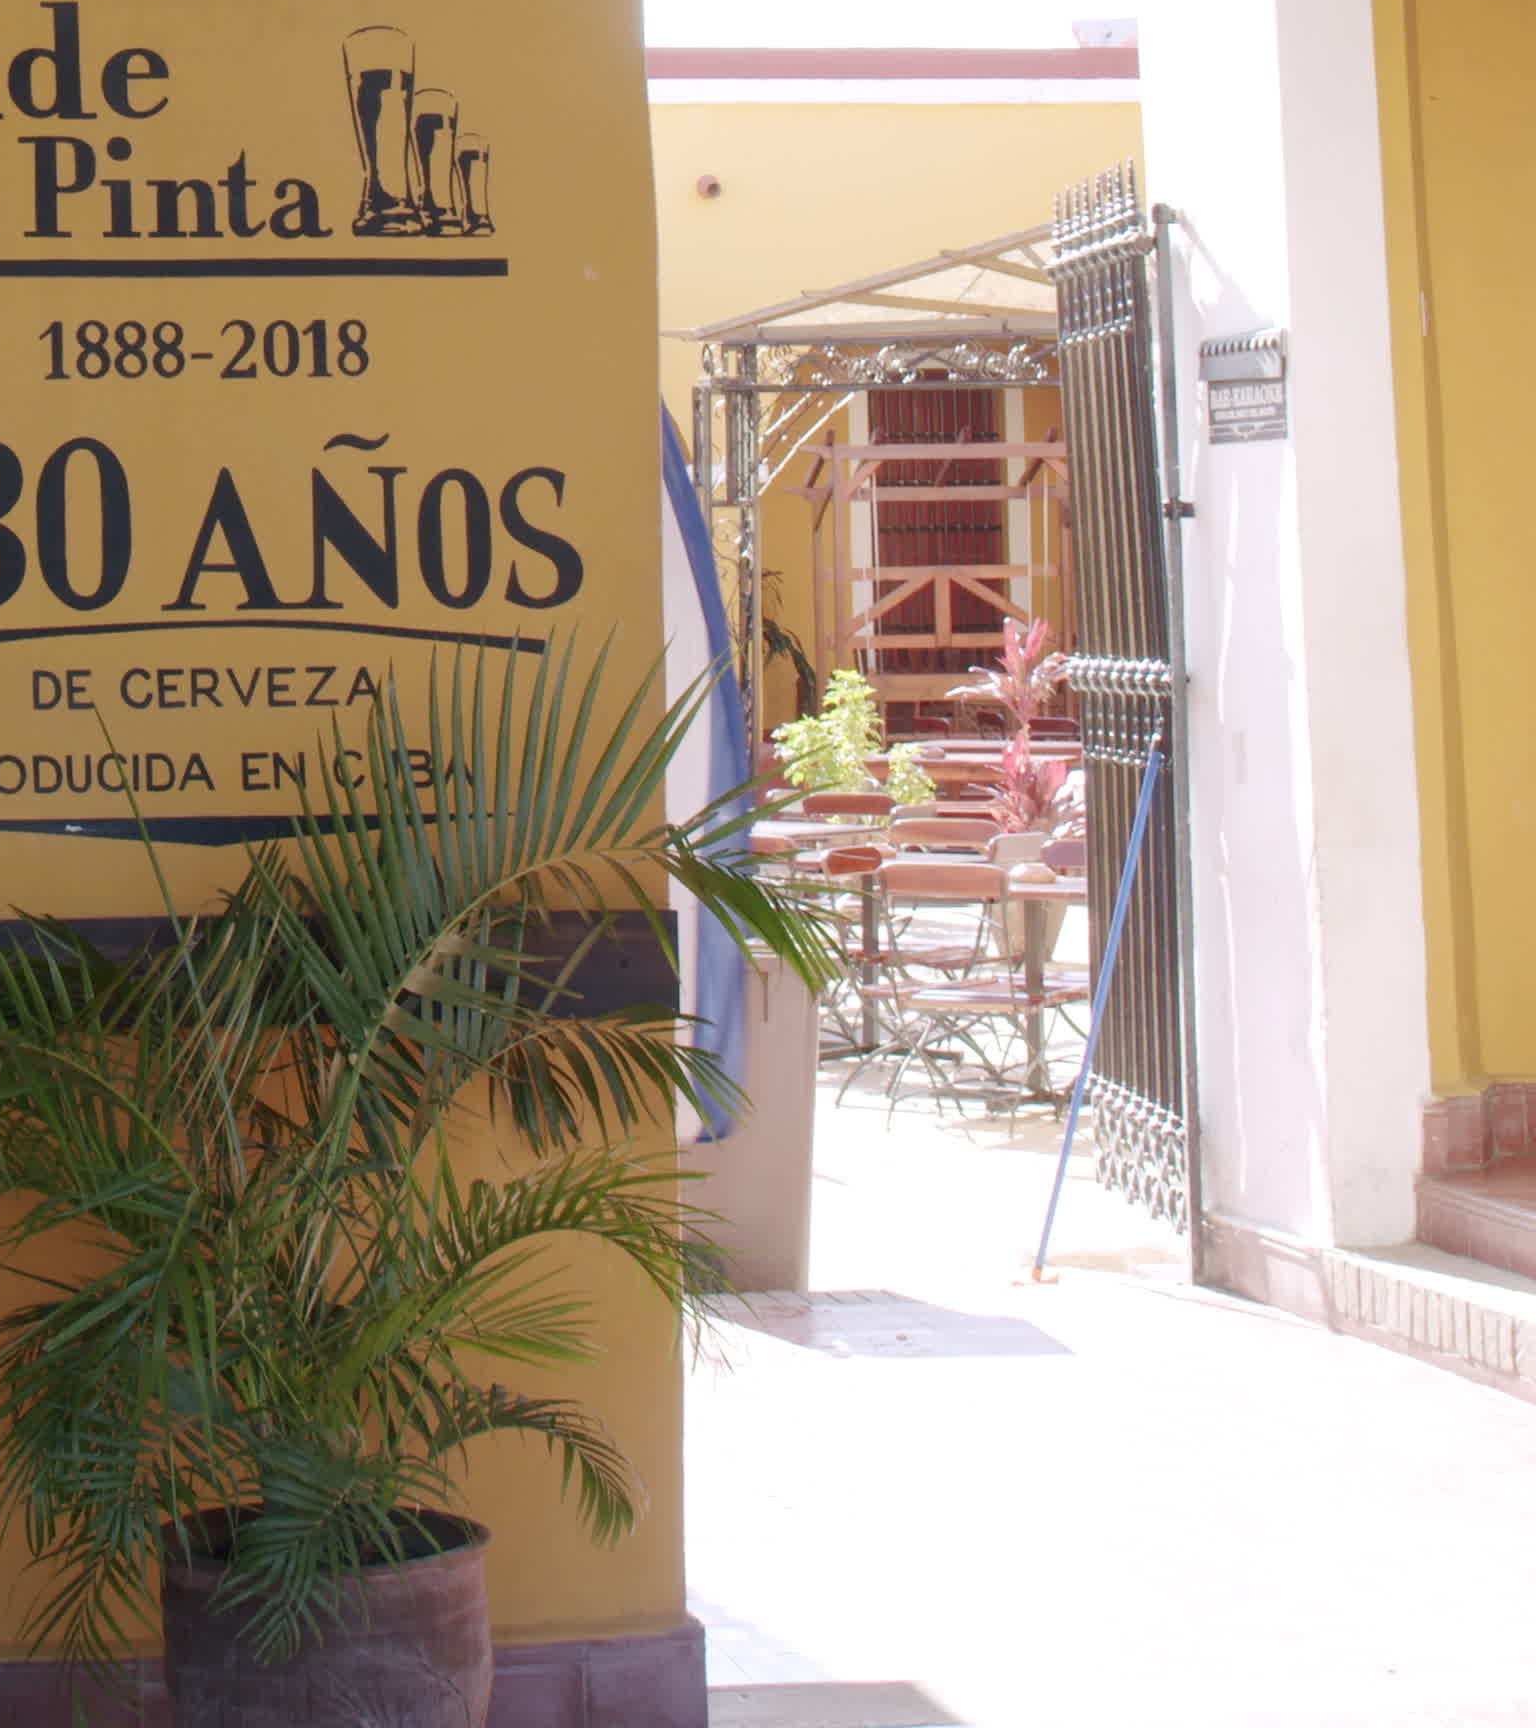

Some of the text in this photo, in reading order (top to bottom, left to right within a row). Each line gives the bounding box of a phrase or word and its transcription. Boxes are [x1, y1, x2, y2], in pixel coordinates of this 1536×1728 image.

[17, 134, 334, 240] Pinta
[38, 318, 371, 381] 1888-2018
[160, 432, 586, 611] AÑOS
[32, 665, 382, 711] DE CERVEZA
[240, 750, 307, 791] EN
[332, 748, 477, 789] CBA
